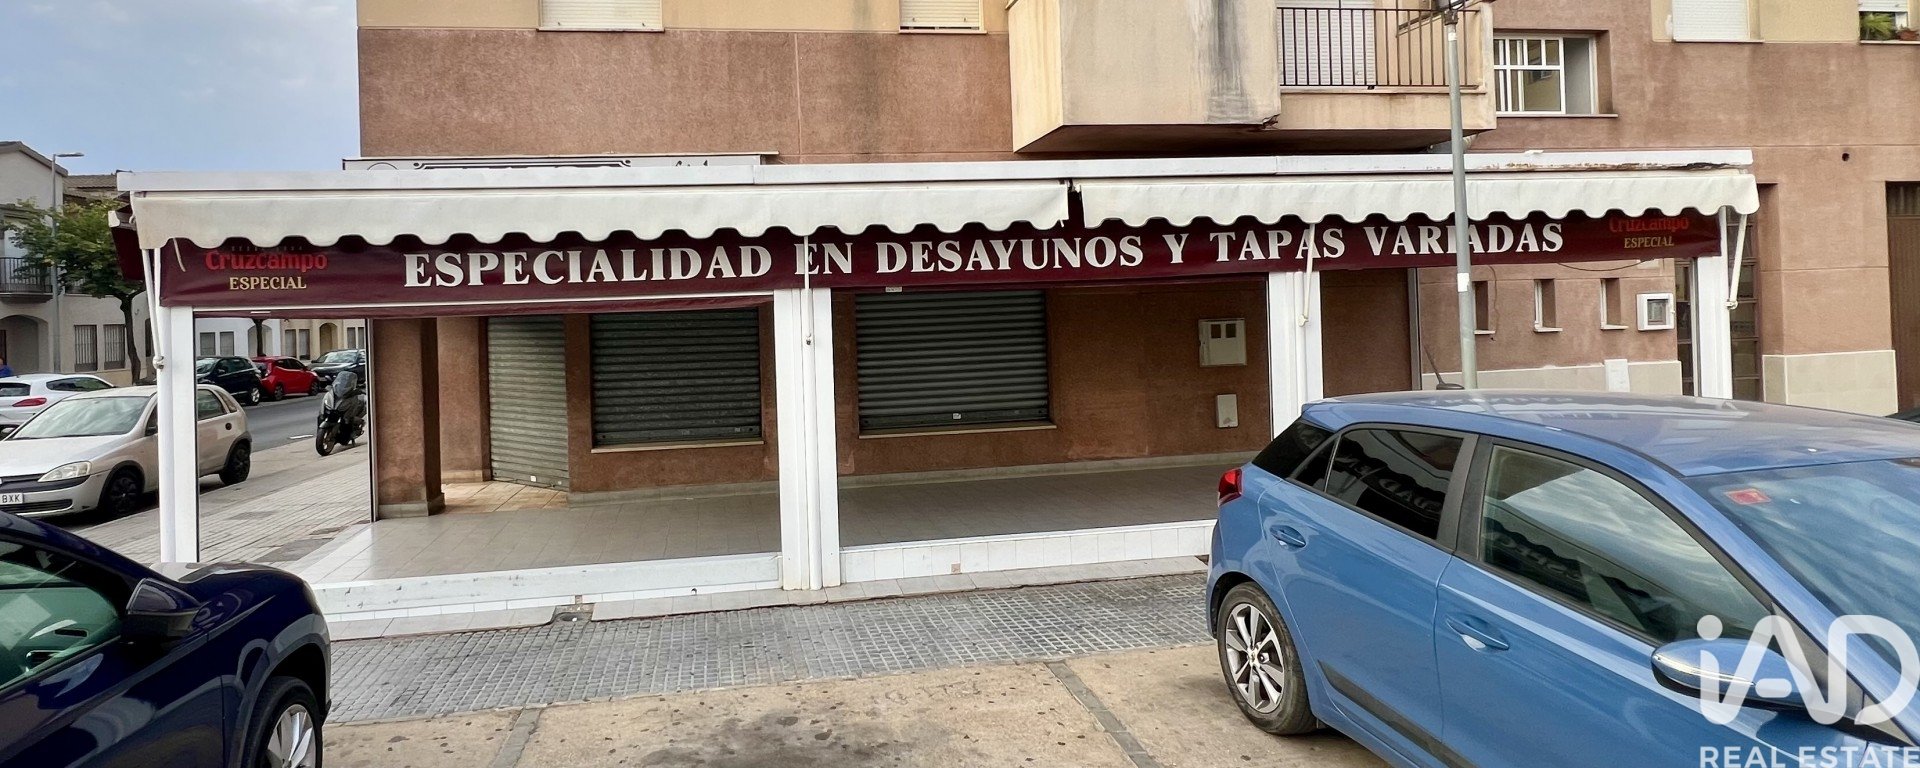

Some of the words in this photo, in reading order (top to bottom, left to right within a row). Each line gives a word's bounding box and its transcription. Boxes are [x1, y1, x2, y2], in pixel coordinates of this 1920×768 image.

[1624, 236, 1674, 249] ESPECIAL
[205, 250, 328, 272] Cruzcampo
[403, 245, 772, 288] ESPECIALIDAD
[794, 243, 853, 274] EN
[876, 235, 1144, 274] DESAYUNOS
[1162, 233, 1190, 264] Y
[1210, 228, 1345, 262] TAPAS
[229, 276, 307, 290] ESPECIAL
[2, 494, 20, 503] BXK
